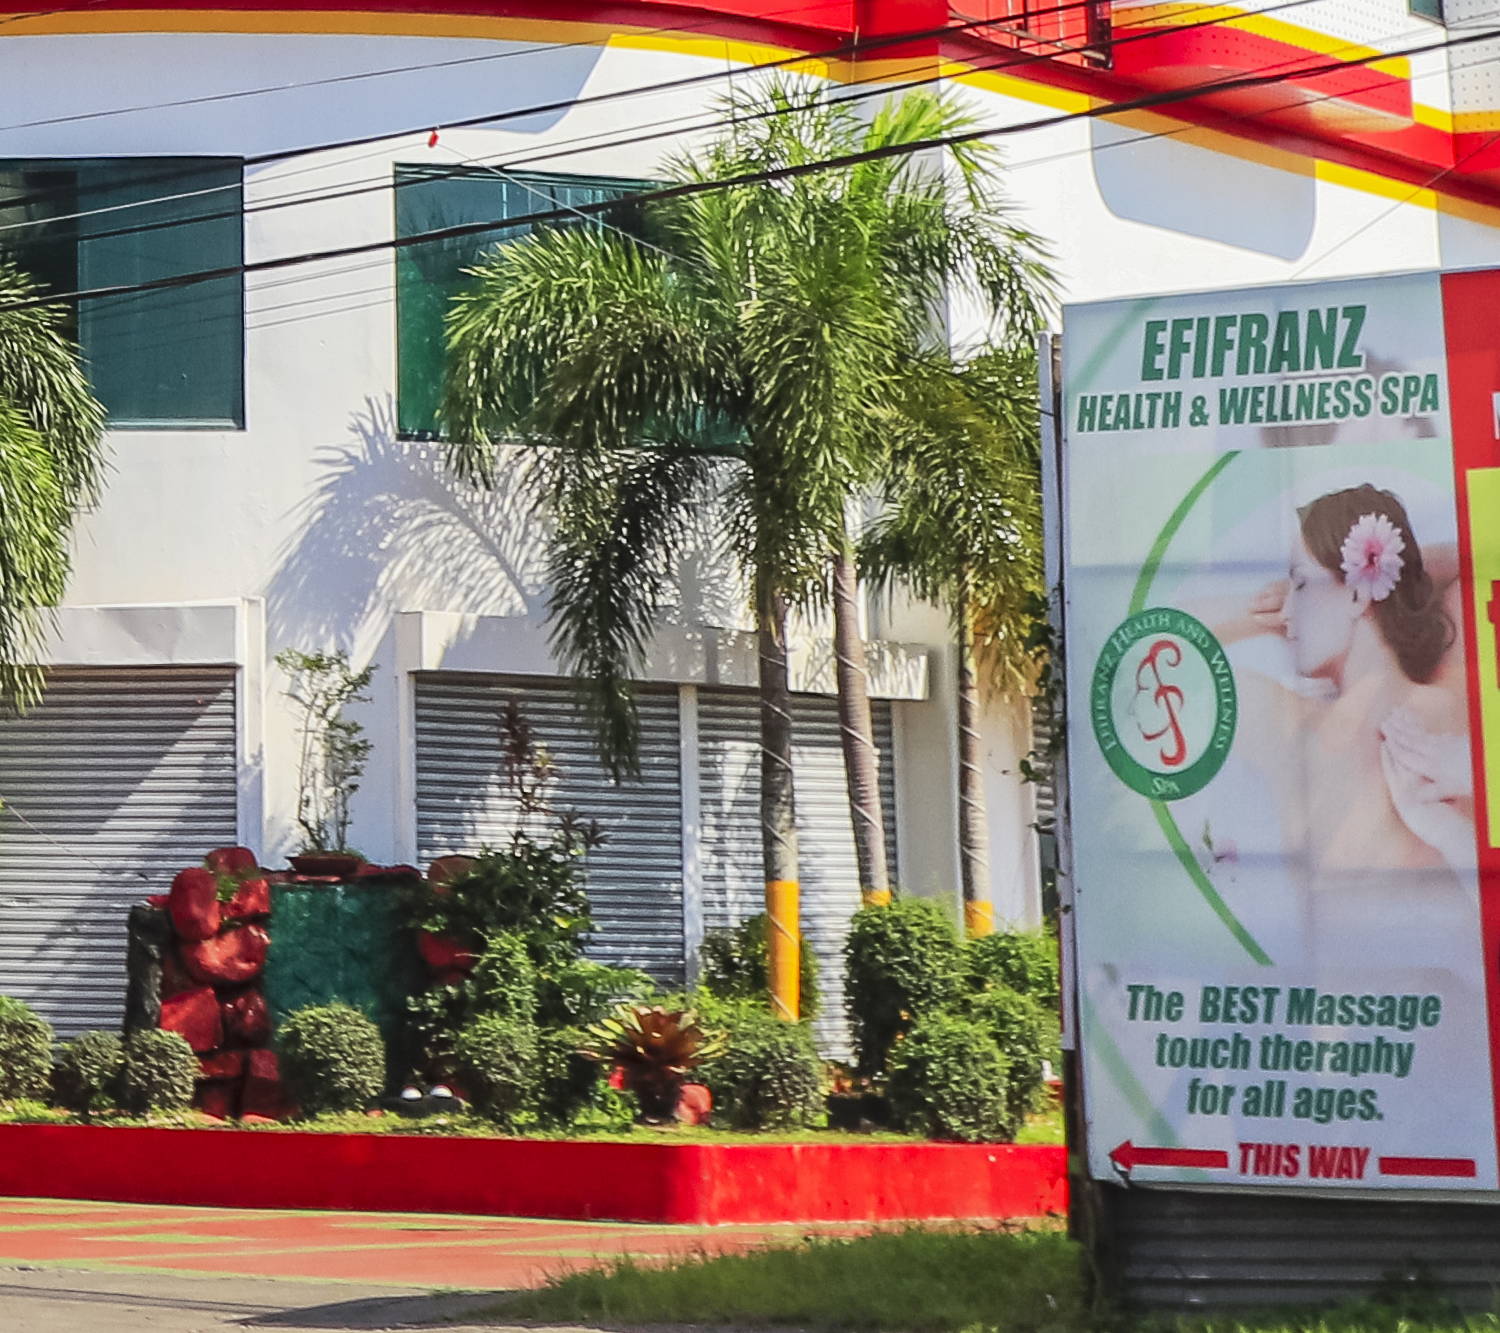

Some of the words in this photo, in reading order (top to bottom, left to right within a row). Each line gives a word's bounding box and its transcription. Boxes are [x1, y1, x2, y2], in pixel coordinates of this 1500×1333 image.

[1141, 305, 1367, 381] EFIFRANZ
[1077, 391, 1182, 432] HEALTH
[1188, 395, 1210, 427] &
[1218, 377, 1373, 425] WELLNESS
[1380, 374, 1440, 416] SPA
[1127, 985, 1185, 1023] The
[1199, 986, 1280, 1025] BEST
[1286, 987, 1442, 1032] Massage
[1155, 1033, 1251, 1071] touch
[1259, 1034, 1416, 1079] theraphy
[1187, 1077, 1236, 1116] for
[1242, 1080, 1287, 1118] all
[1293, 1086, 1384, 1125] ages.
[1238, 1142, 1301, 1178] THIS
[1308, 1145, 1371, 1180] WAY
